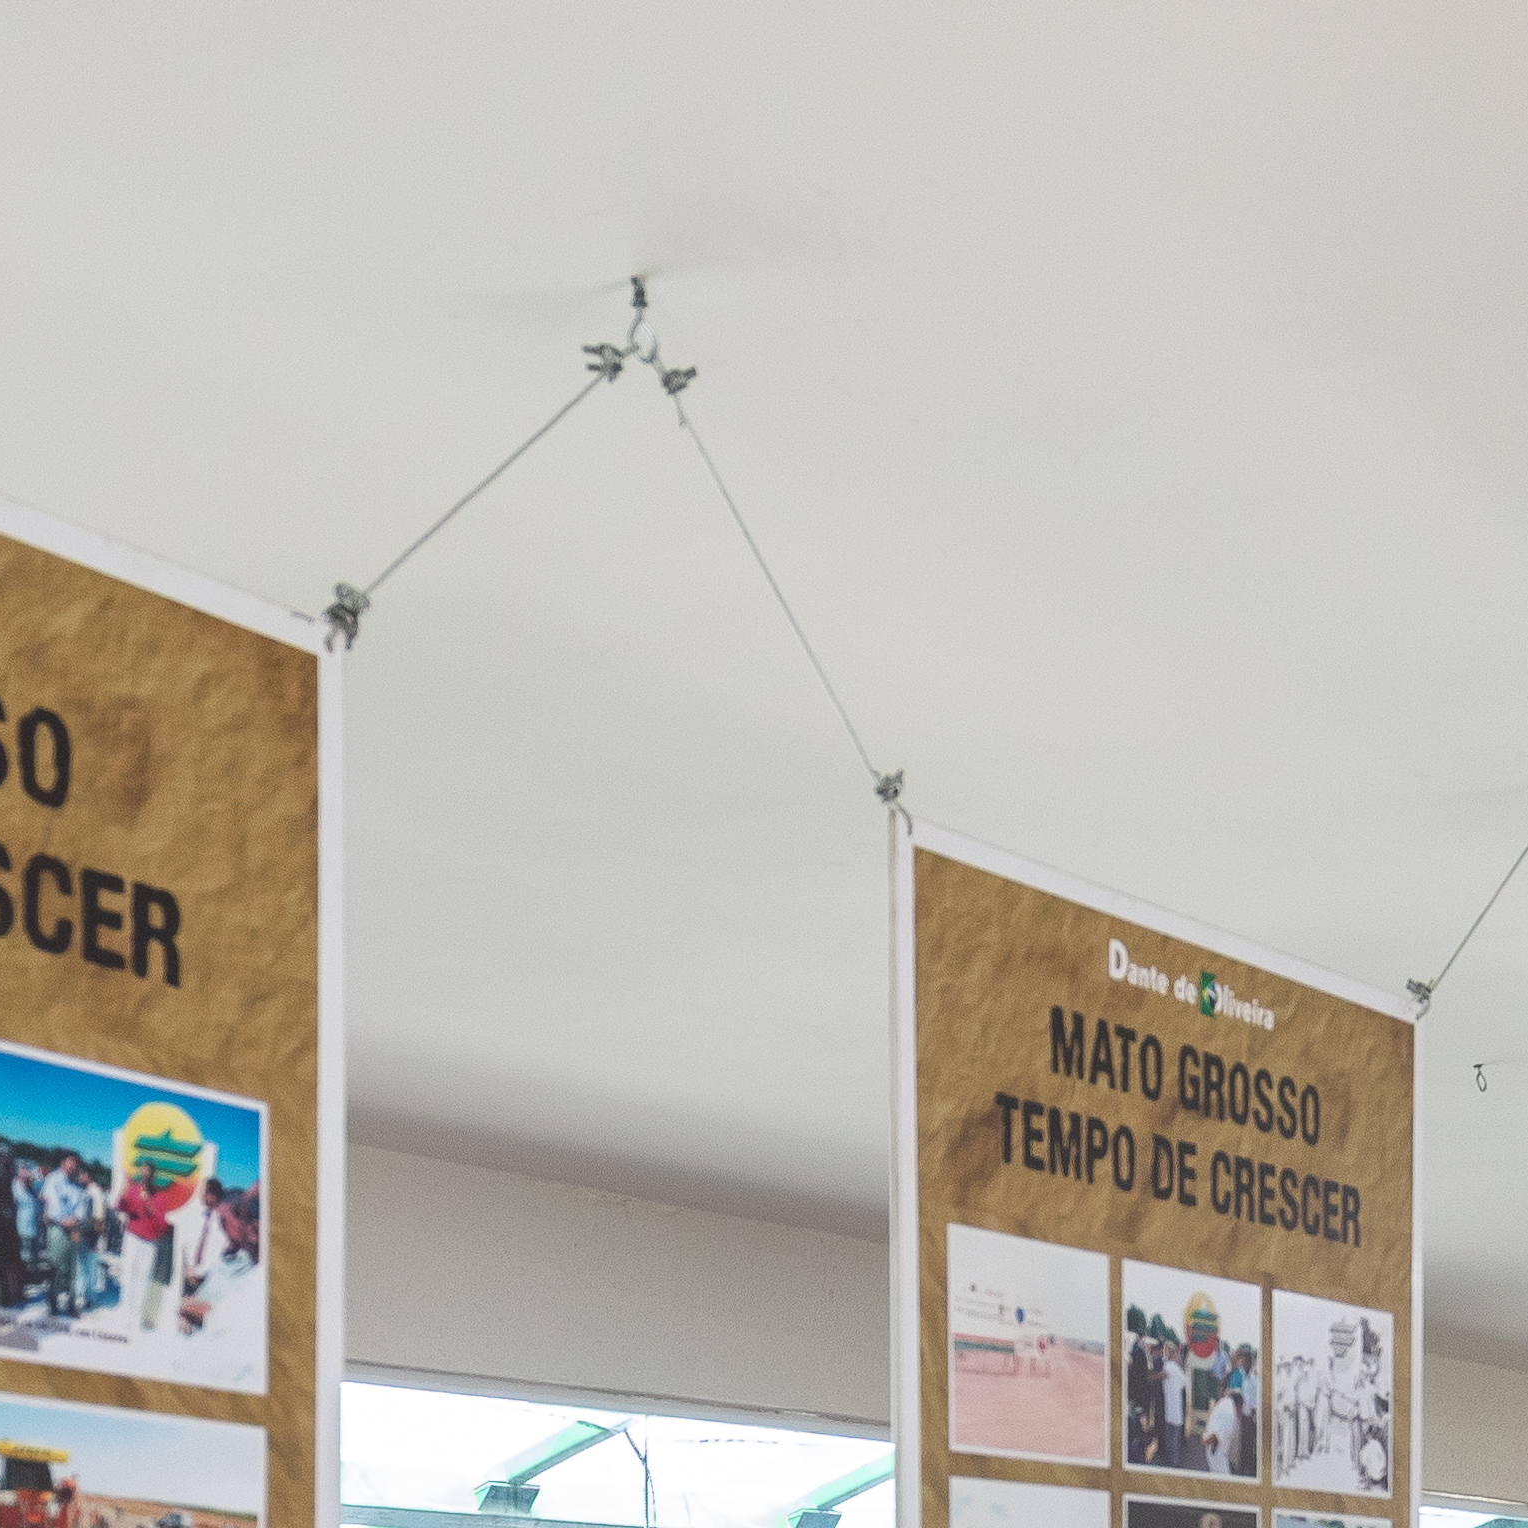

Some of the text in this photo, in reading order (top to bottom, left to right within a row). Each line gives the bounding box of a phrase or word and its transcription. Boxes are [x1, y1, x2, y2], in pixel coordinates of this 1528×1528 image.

[1107, 937, 1276, 1032] Dante de Oliveira
[1049, 1004, 1321, 1146] MATO GROSSO
[995, 1091, 1361, 1248] TEMPO DE CRESCER
